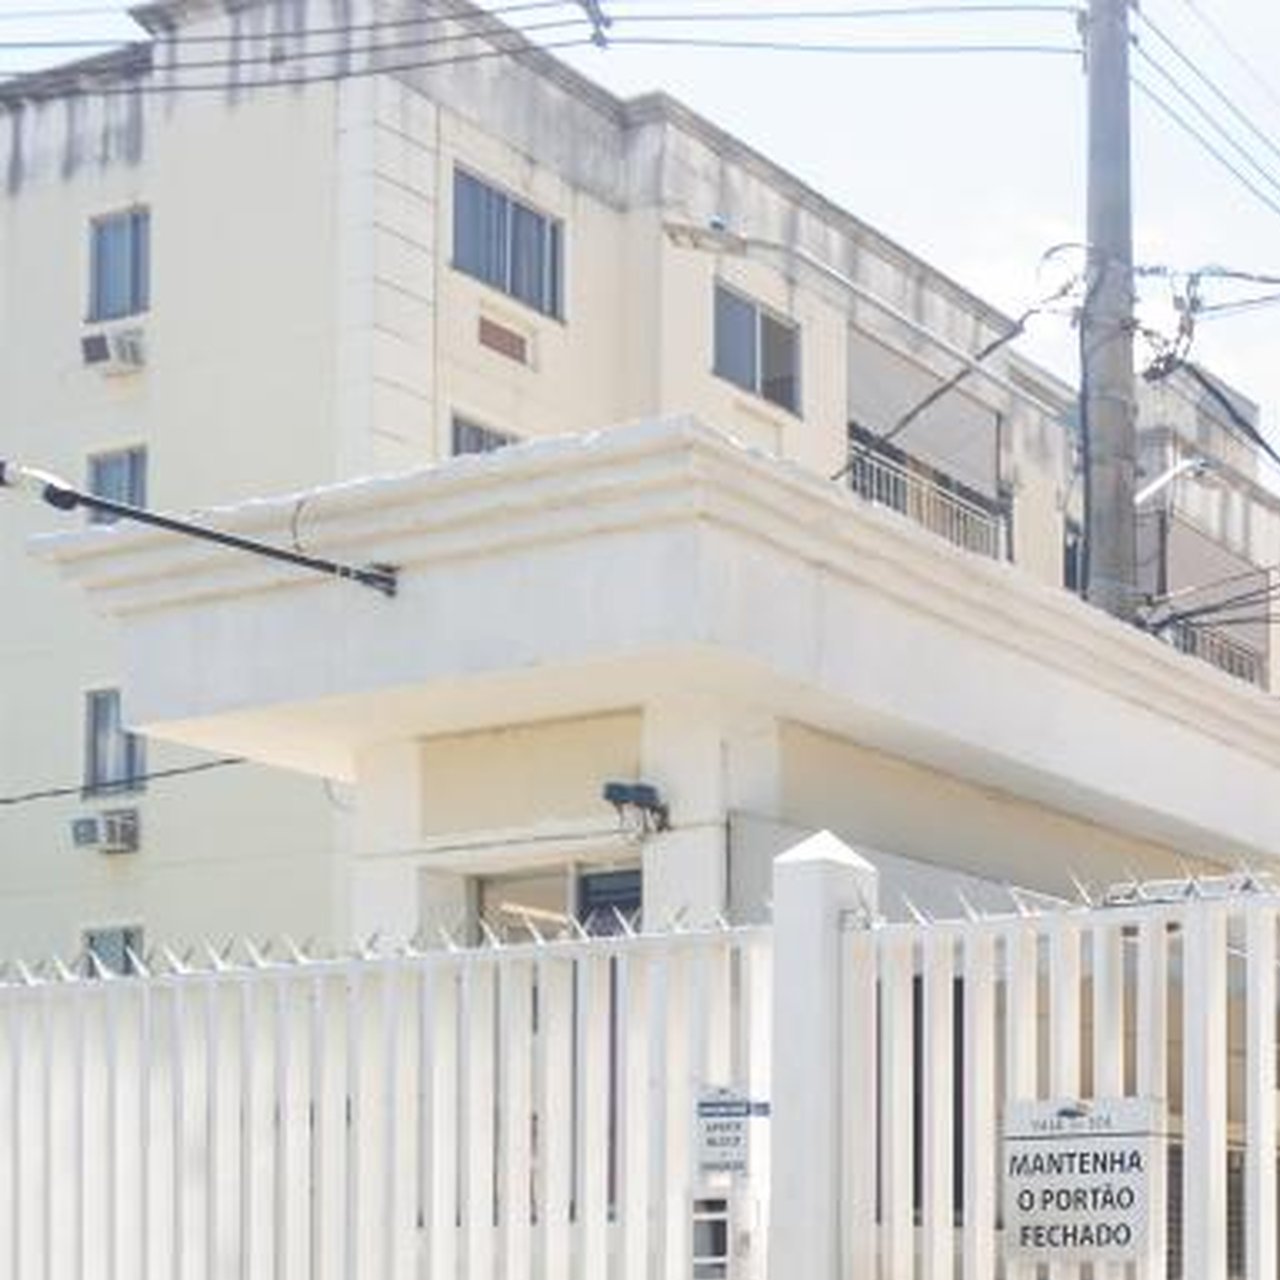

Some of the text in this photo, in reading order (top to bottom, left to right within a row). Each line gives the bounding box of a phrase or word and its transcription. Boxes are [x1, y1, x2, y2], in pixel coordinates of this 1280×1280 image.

[1009, 1150, 1143, 1176] MANTENHA
[1018, 1182, 1135, 1211] O PORTÃO
[1020, 1223, 1132, 1248] FECHADO
